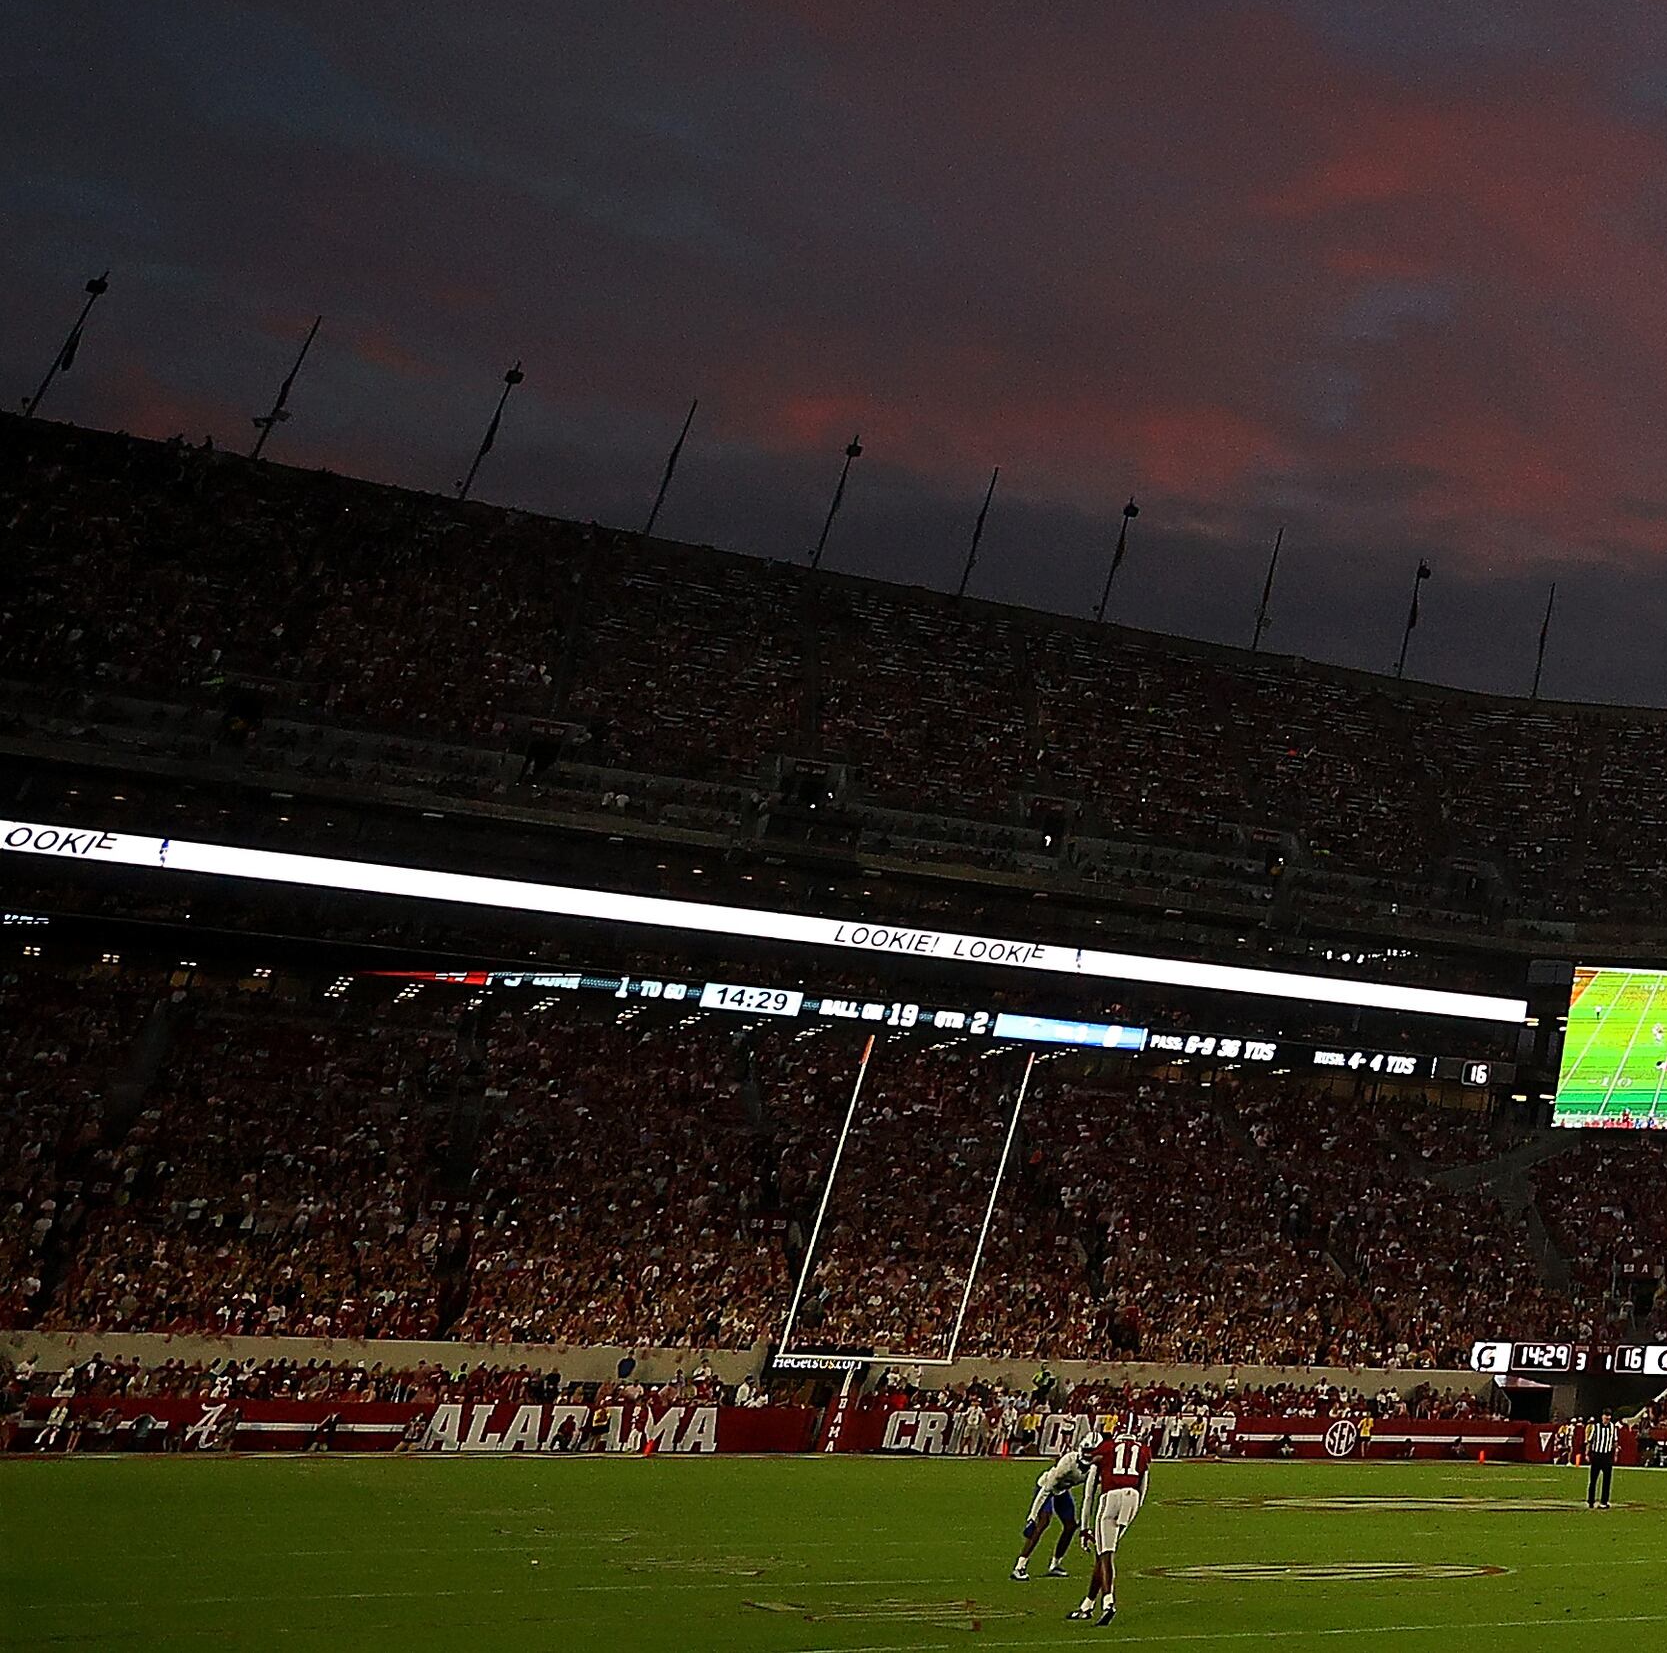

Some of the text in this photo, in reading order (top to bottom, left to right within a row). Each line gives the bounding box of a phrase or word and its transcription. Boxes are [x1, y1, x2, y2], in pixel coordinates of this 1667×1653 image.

[834, 925, 1046, 964] LOOKIE! LOOKIE
[717, 987, 788, 1011] 14:29
[887, 1002, 920, 1027] 19
[970, 1011, 990, 1034] 2
[1244, 1041, 1278, 1061] YDS
[1386, 1055, 1417, 1075] YDS
[1470, 1065, 1488, 1084] 16
[1521, 1346, 1567, 1366] 14:29
[1575, 1353, 1586, 1371] 3
[1606, 1354, 1612, 1370] 1
[1624, 1349, 1642, 1367] 16
[1325, 1421, 1357, 1456] SEC
[1112, 1442, 1139, 1476] 11
